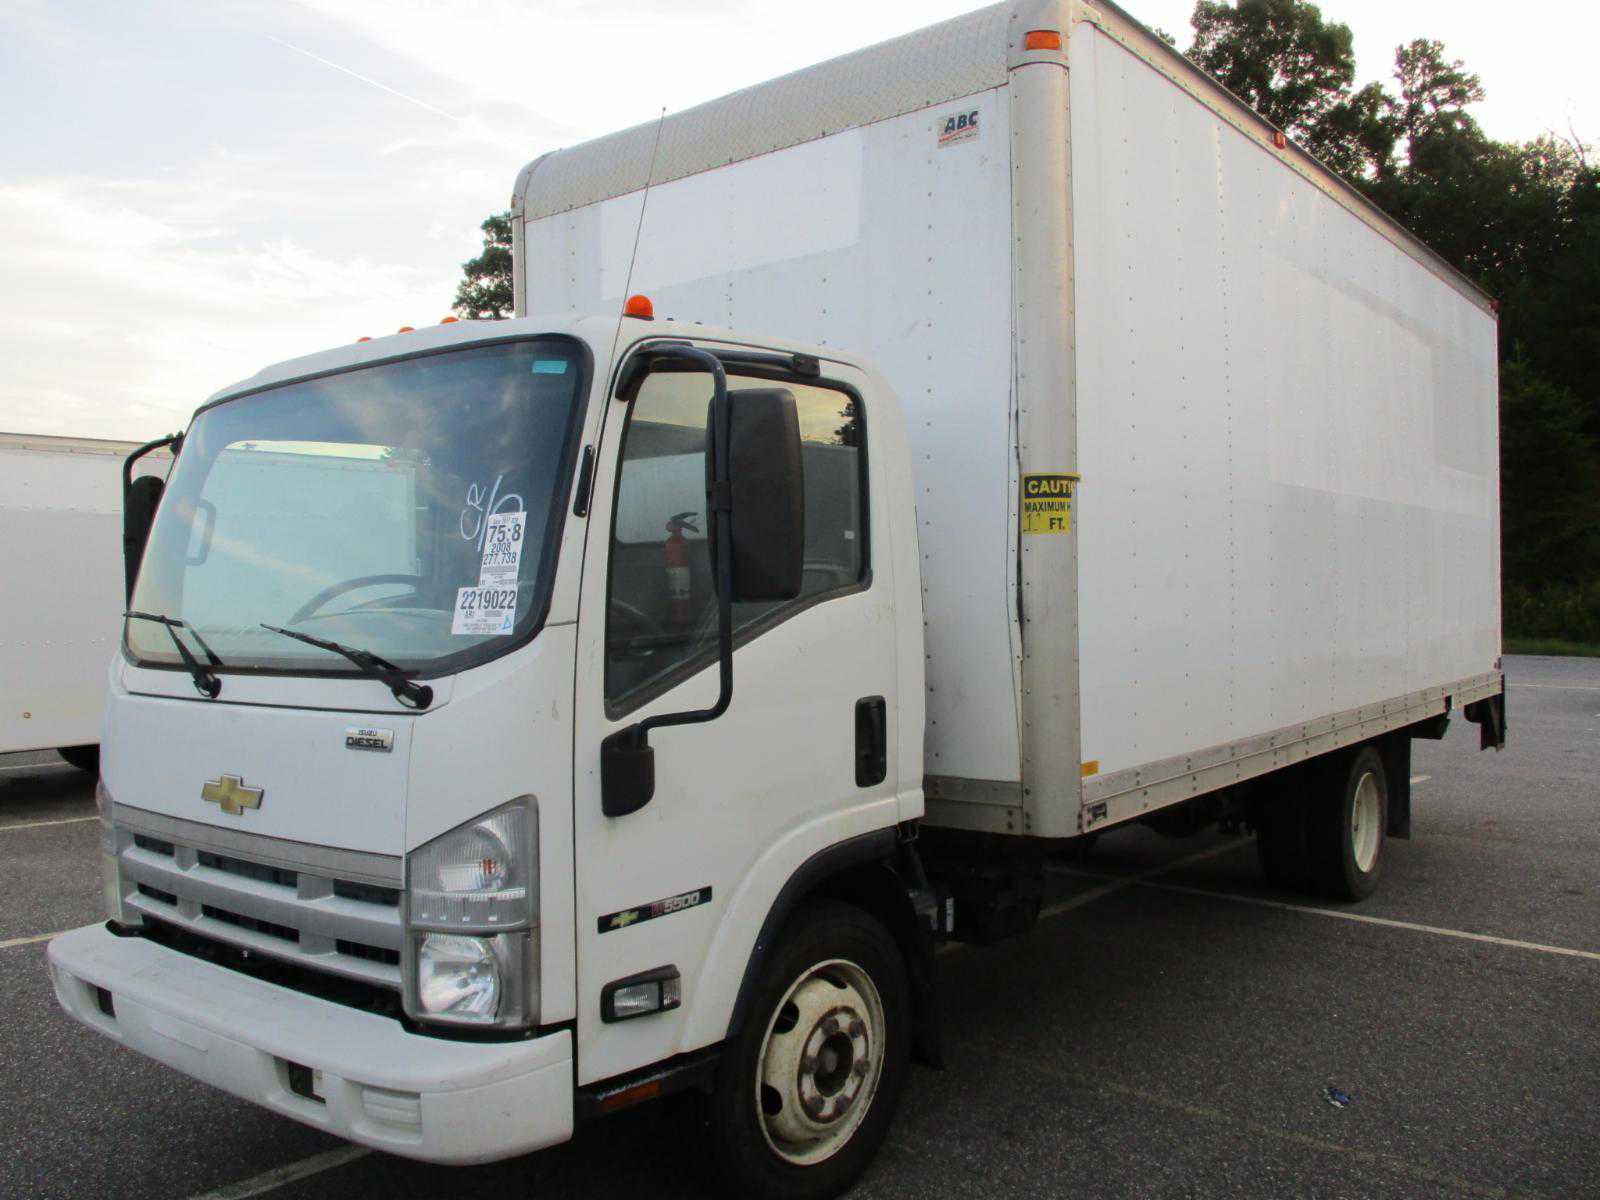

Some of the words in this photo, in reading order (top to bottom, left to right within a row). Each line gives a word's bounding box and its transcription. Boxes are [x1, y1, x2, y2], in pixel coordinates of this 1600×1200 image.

[944, 111, 978, 132] ABC
[1024, 502, 1065, 512] MAXIMUM
[1049, 517, 1065, 530] FT.
[460, 590, 516, 610] 2219022
[345, 736, 388, 750] DIESEL
